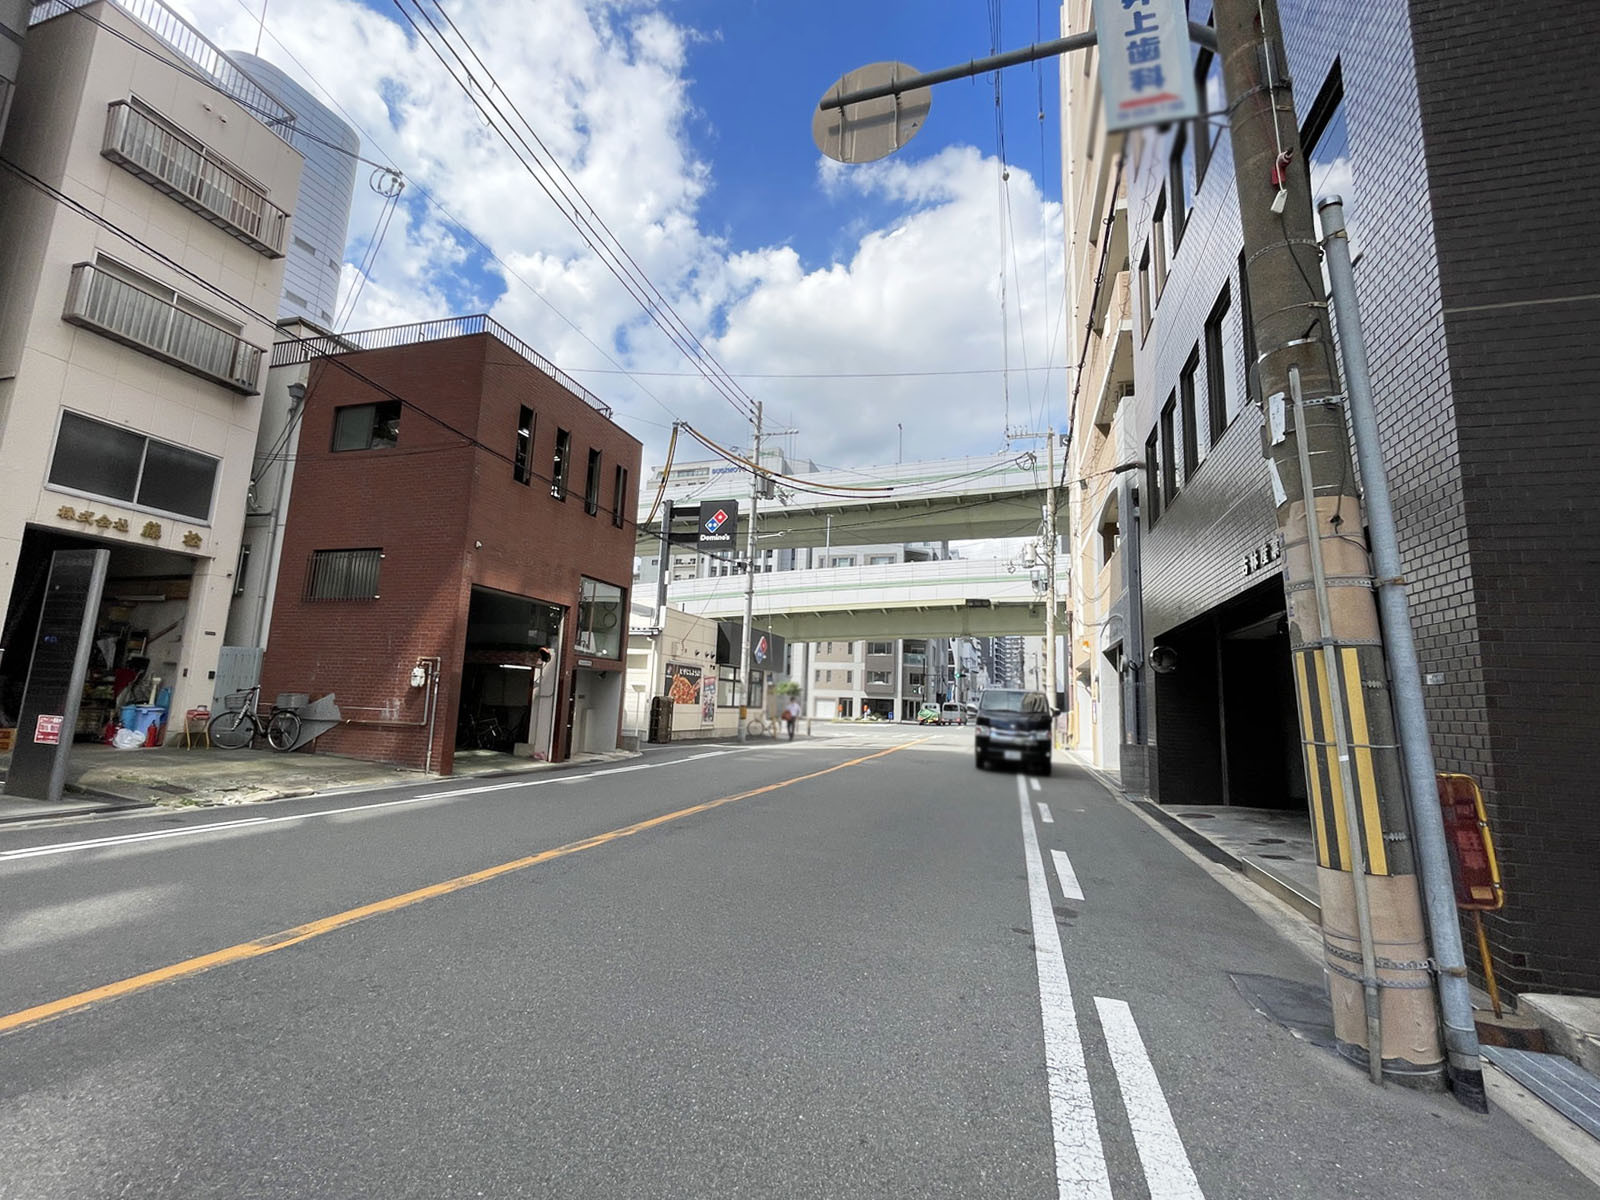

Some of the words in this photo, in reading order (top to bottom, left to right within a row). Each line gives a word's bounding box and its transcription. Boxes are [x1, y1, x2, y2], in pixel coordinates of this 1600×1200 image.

[1121, 0, 1165, 92] 上歯科
[56, 505, 129, 533] 株式会社
[700, 533, 731, 541] Domino's
